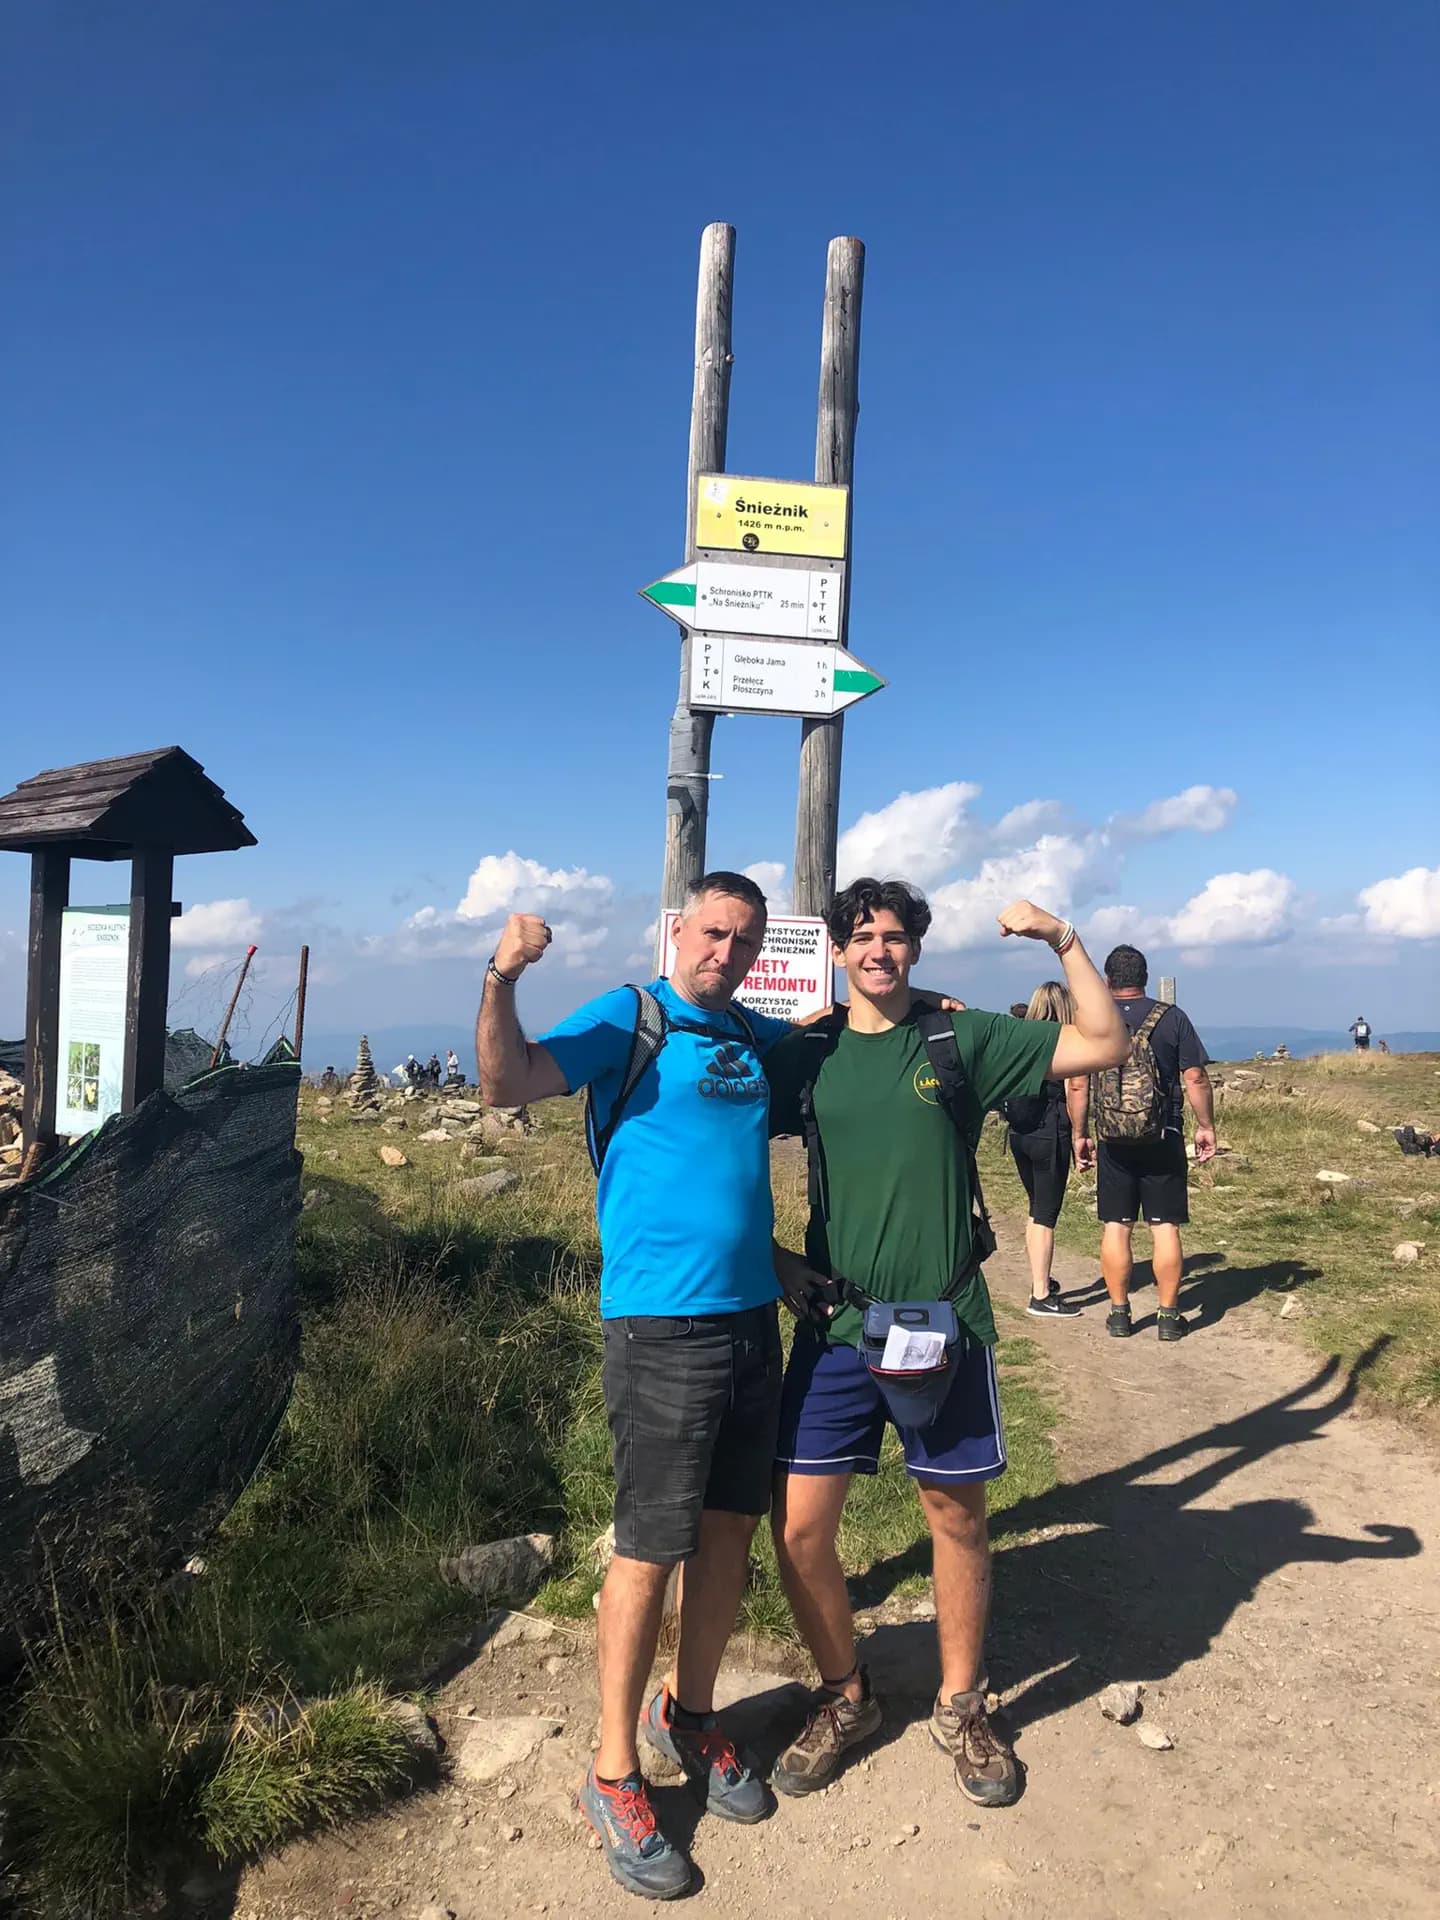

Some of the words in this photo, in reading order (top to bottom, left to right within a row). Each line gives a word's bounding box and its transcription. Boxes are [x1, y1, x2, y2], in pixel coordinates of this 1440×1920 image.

[735, 496, 809, 519] Śnieżnik
[738, 519, 761, 529] 1426
[776, 523, 806, 533] n.p.m.
[709, 586, 751, 598] Schronisko
[753, 590, 773, 599] PTTK
[780, 599, 790, 608] 25
[790, 600, 805, 609] min
[766, 657, 786, 667] Jama
[764, 927, 821, 937] RYSTYCZNY
[762, 936, 818, 946] CHRONISKA
[770, 945, 816, 955] ŚNIEŻNIK
[743, 976, 817, 993] REMONTU
